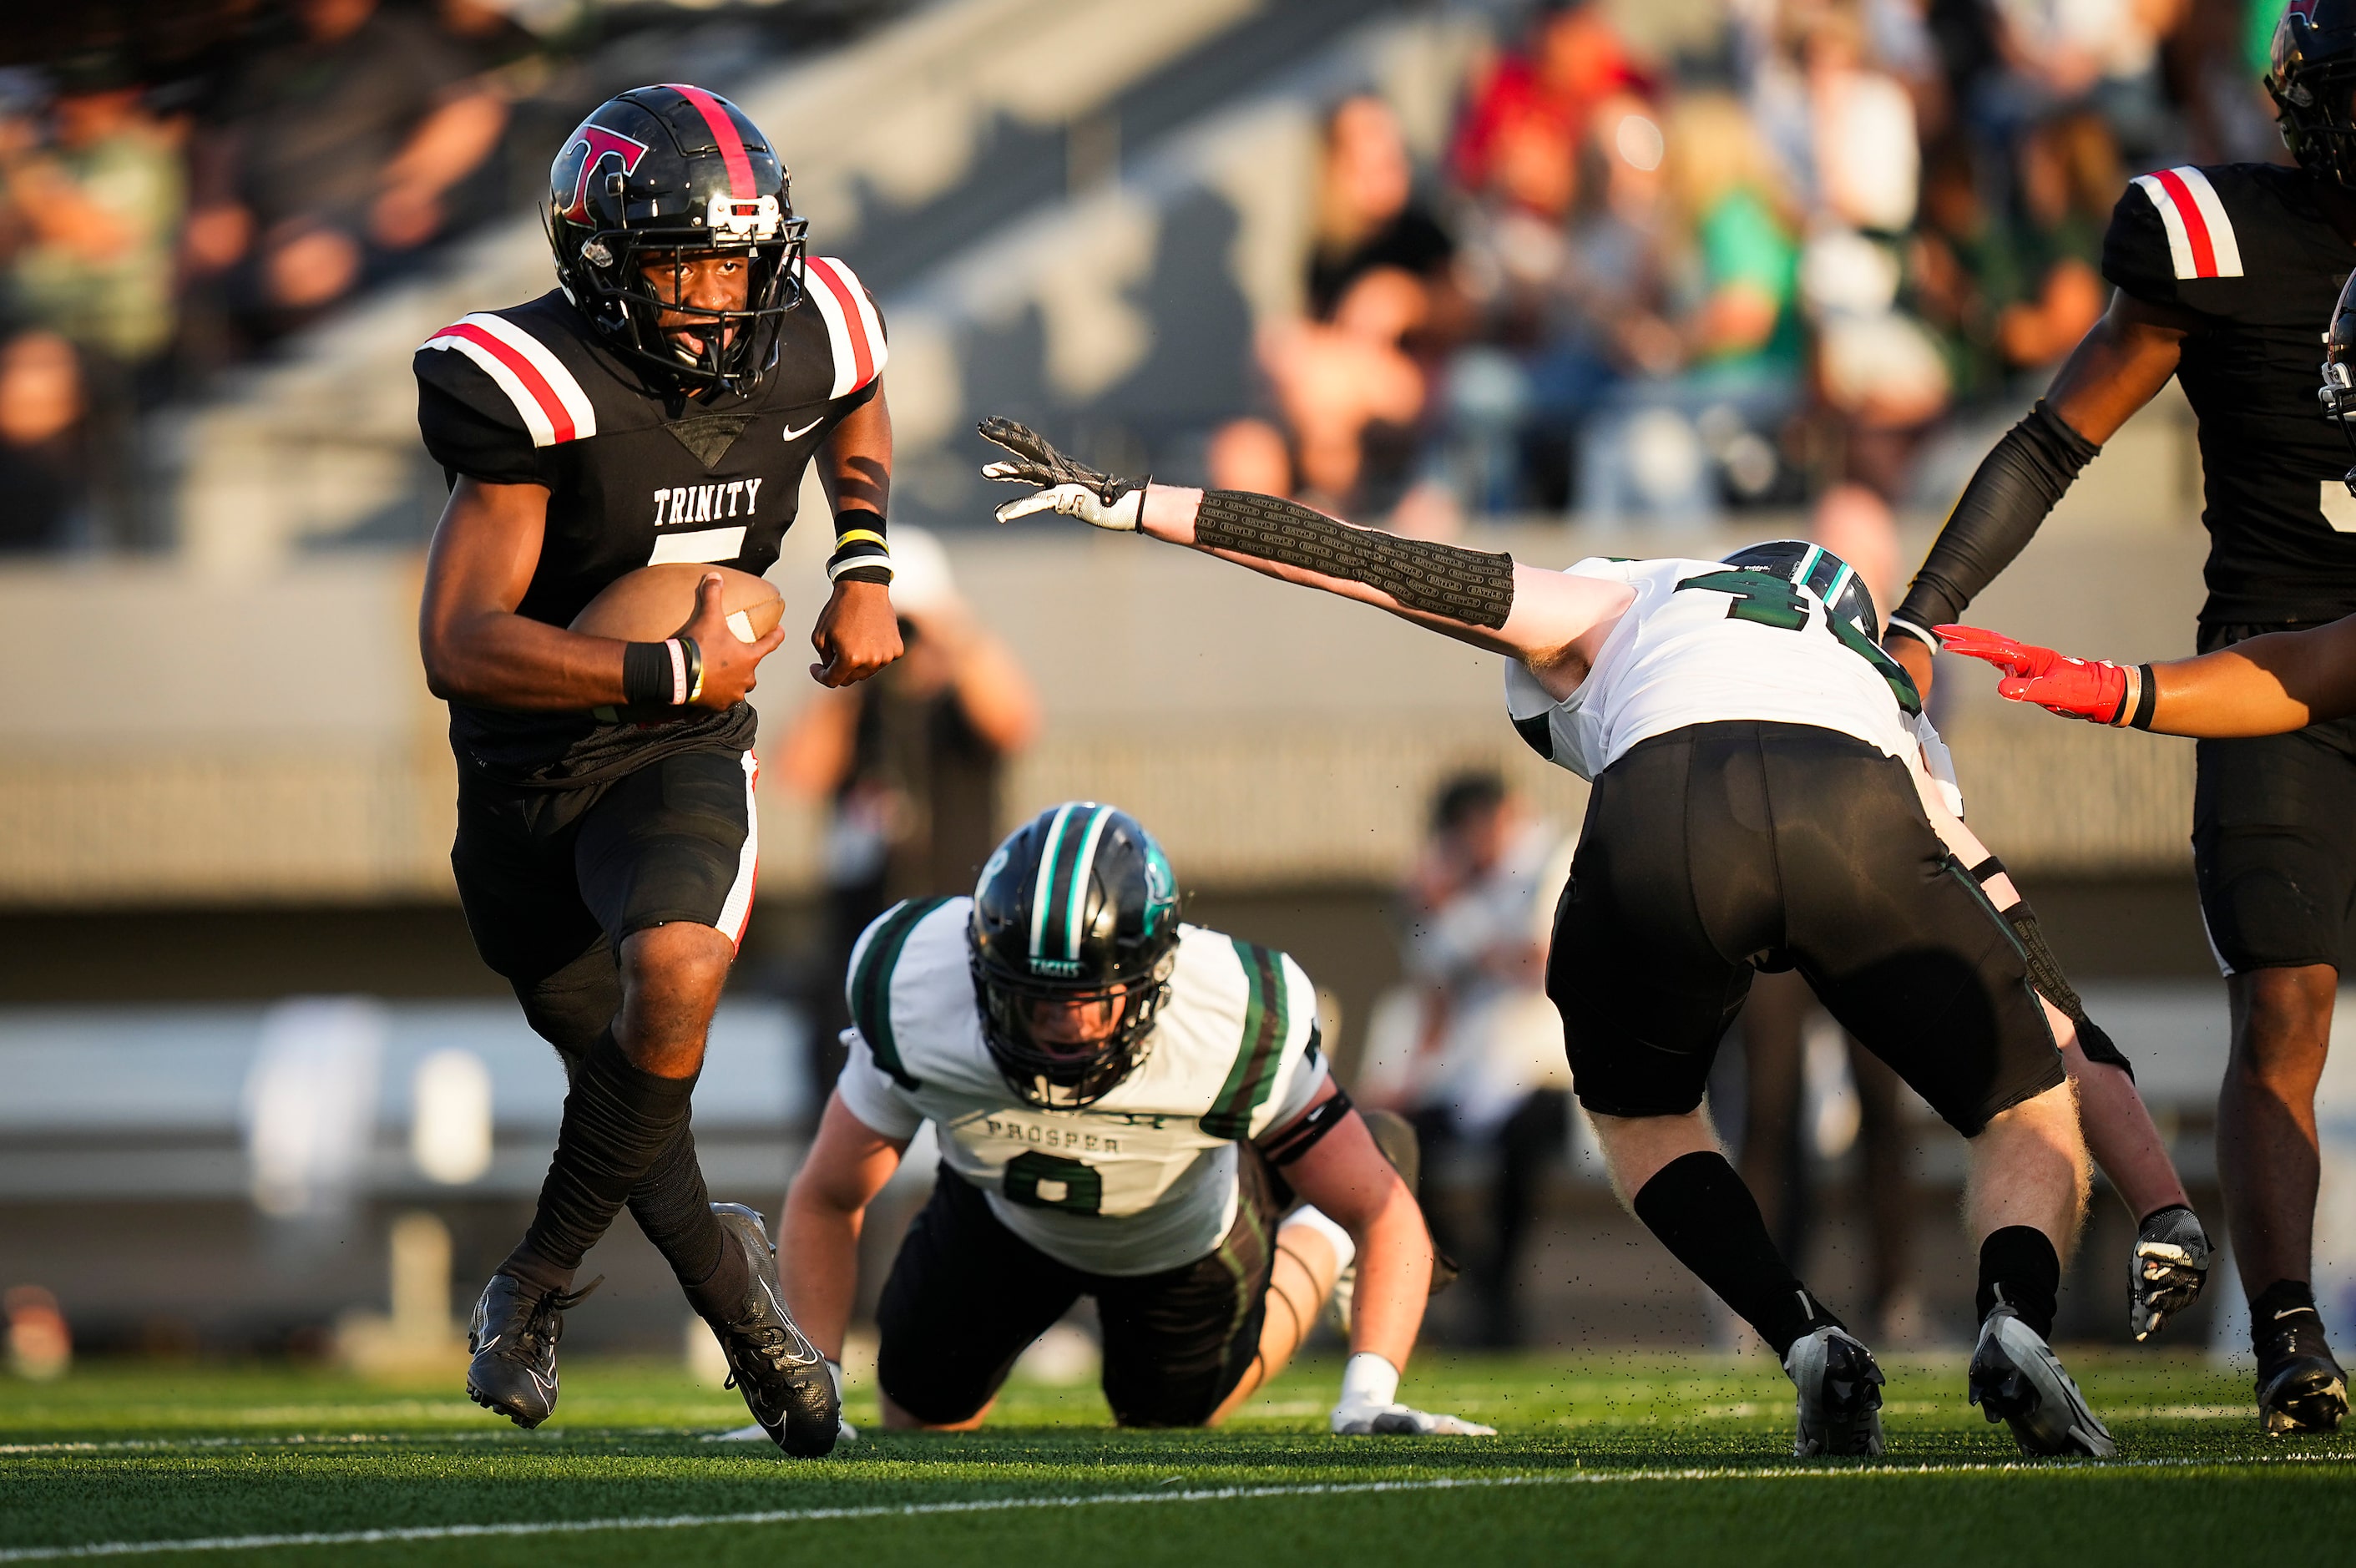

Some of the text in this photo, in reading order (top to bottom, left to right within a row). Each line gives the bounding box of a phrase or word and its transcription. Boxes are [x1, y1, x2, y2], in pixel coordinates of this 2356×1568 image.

[566, 124, 649, 230] T
[654, 478, 762, 527] TRINITY
[1228, 502, 1257, 515] BATTLE
[1206, 508, 1235, 521] BATTLE
[1268, 511, 1297, 524] BATTLE
[1224, 523, 1252, 537] BATTLE
[1246, 517, 1275, 529] BATTLE
[1308, 522, 1334, 534] BATTLE
[1264, 533, 1293, 546] BATTLE
[1286, 526, 1314, 539] BATTLE
[1241, 541, 1271, 554] BATTLE
[1302, 543, 1331, 556] BATTLE
[1324, 536, 1349, 551] BATTLE
[1398, 543, 1426, 556] BATTLE
[1281, 550, 1309, 564] BATTLE
[1435, 553, 1462, 568] BATTLE
[1319, 560, 1347, 574] BATTLE
[1394, 559, 1420, 578] BATTLE
[1416, 556, 1443, 573] BATTLE
[1473, 565, 1499, 575] BATTLE
[1430, 574, 1459, 589] BATTLE
[1453, 569, 1482, 583] BATTLE
[1388, 580, 1413, 599] BATTLE
[1409, 578, 1436, 594] BATTLE
[1470, 586, 1501, 599] BATTLE
[1420, 598, 1451, 611] BATTLE
[1447, 593, 1478, 606] BATTLE
[1463, 609, 1494, 623] BATTLE
[670, 643, 683, 679] ENOUGH
[675, 680, 683, 689] IS
[1029, 958, 1079, 979] EAGLES
[986, 1119, 1120, 1154] PROSPER
